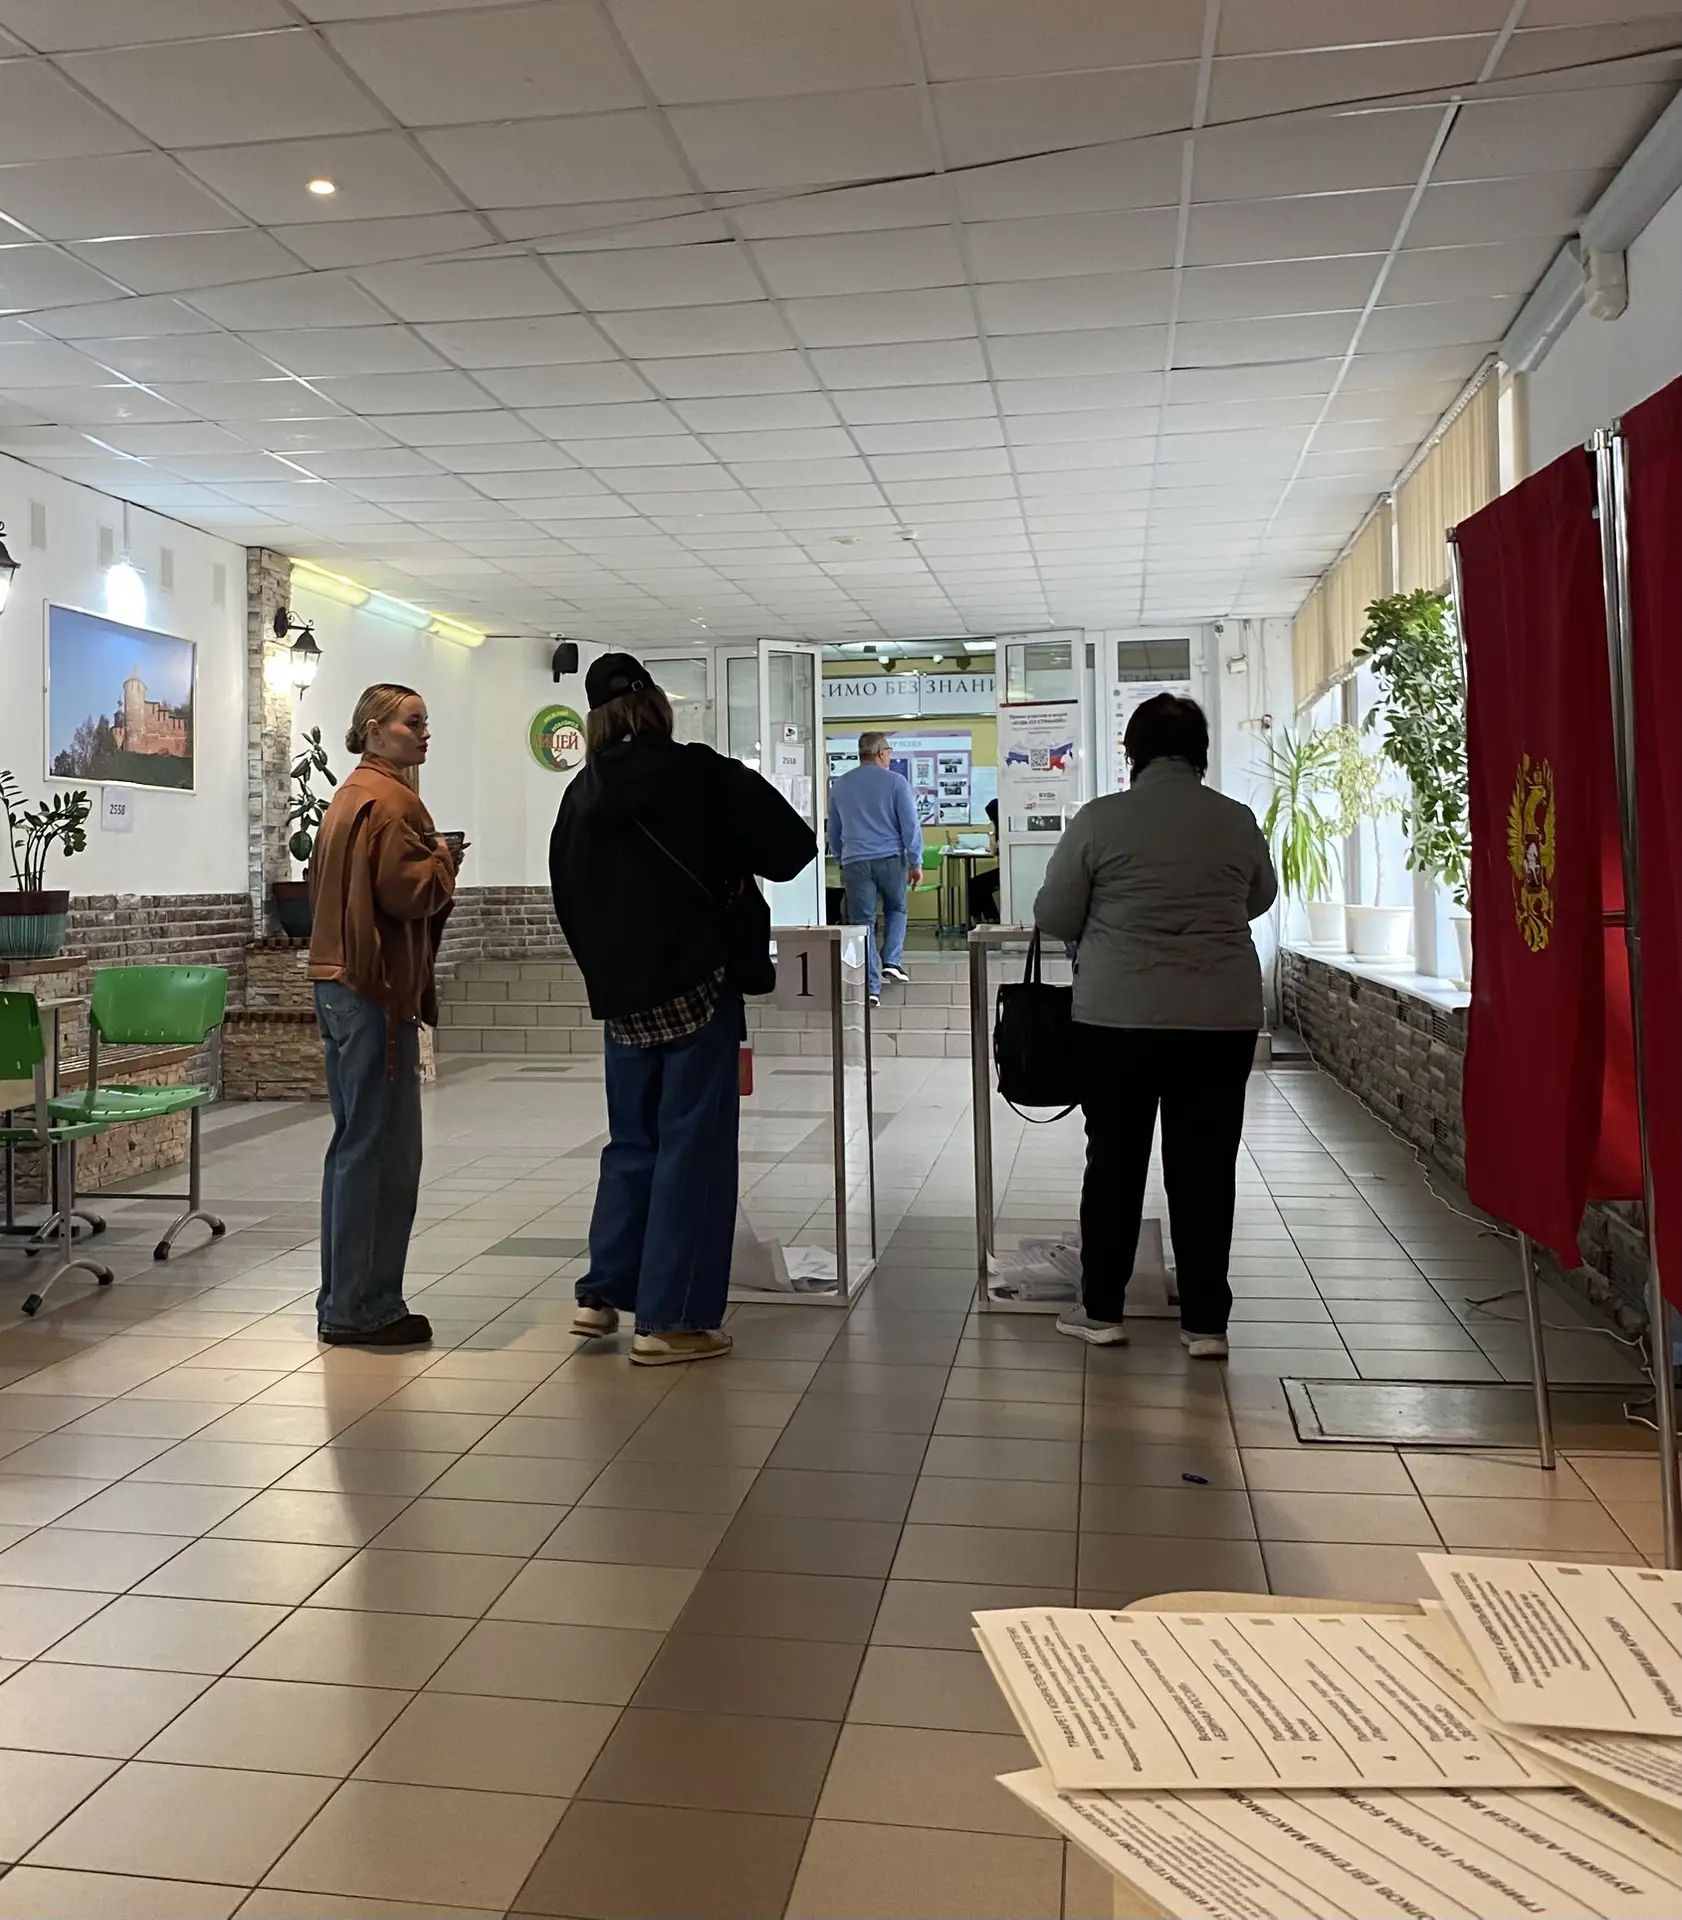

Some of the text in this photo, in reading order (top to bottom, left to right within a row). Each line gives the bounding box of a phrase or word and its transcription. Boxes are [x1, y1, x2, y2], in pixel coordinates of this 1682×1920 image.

[821, 682, 877, 697] ИМО
[885, 680, 919, 695] БЕЗ
[796, 951, 814, 997] 1
[1384, 1818, 1452, 1857] ТАТЬЯНА
[1483, 1810, 1561, 1850] АЛЕКСЕЙ
[1304, 1843, 1378, 1885] ЕВГЕНИЙ
[1454, 1859, 1544, 1912] ГРИНЕВИЧ
